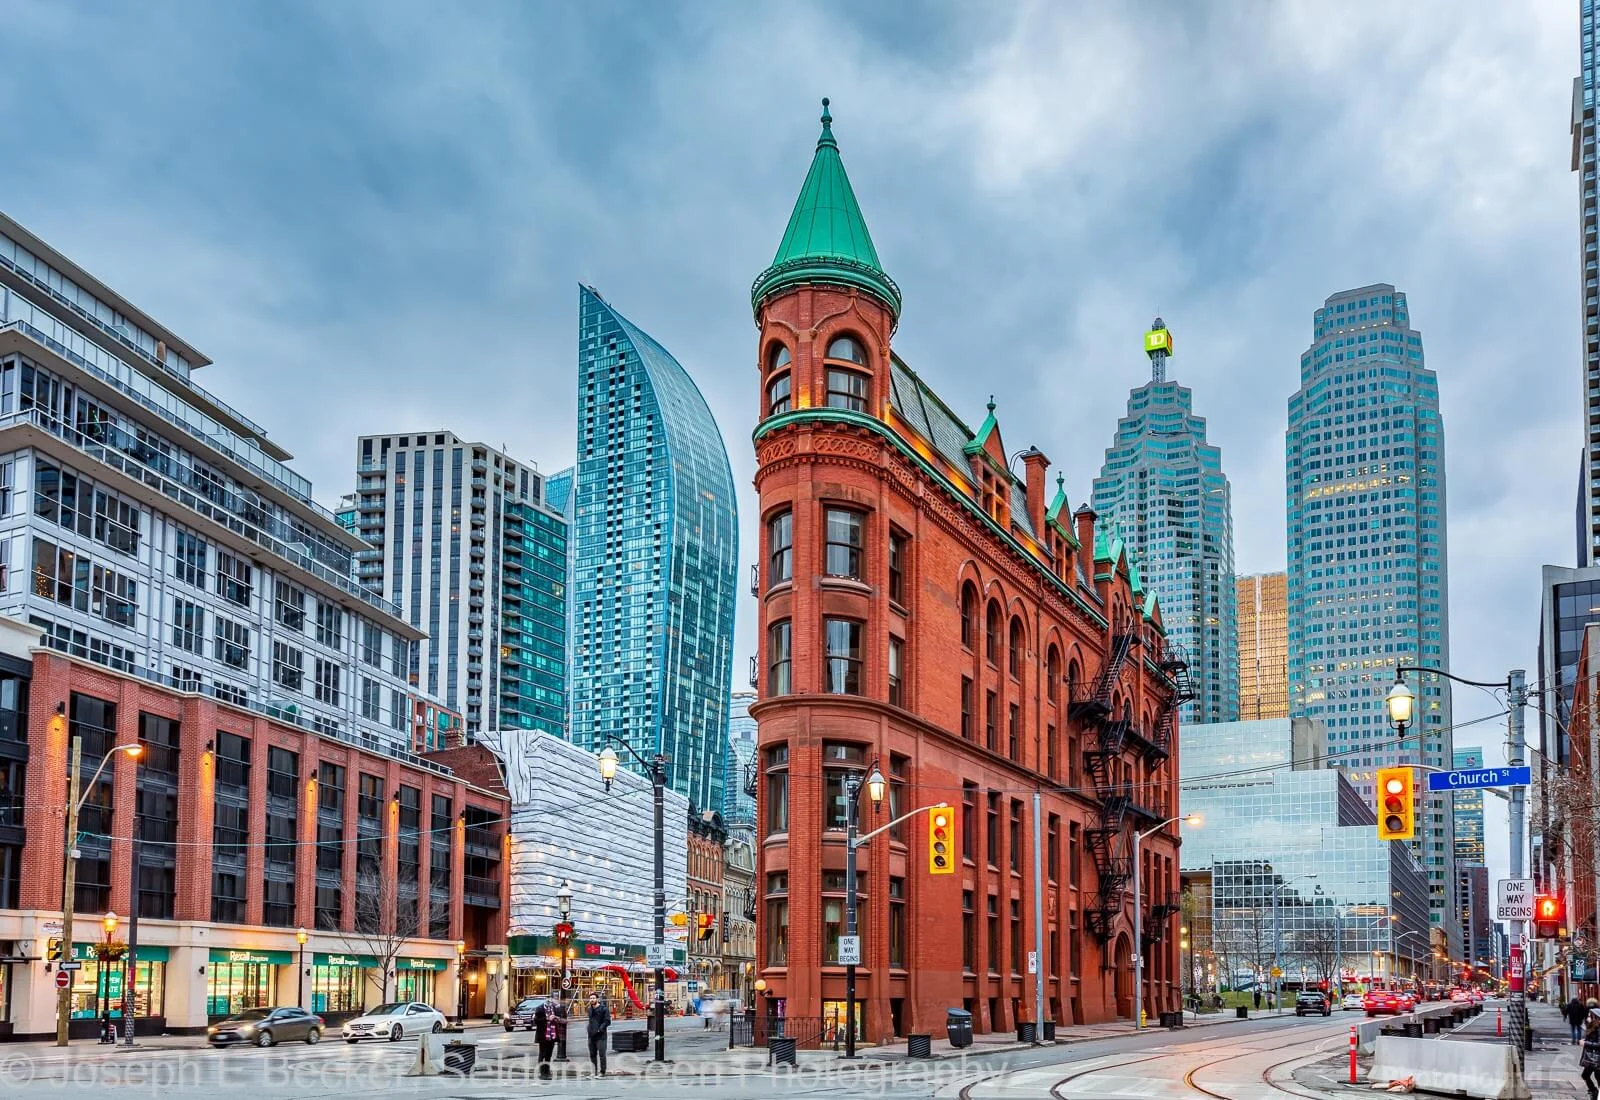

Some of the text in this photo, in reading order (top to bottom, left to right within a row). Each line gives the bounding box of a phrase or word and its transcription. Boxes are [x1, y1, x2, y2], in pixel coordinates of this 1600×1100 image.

[1448, 769, 1498, 786] Church
[1506, 882, 1525, 892] ONE
[1506, 894, 1525, 904] WAY
[1499, 907, 1532, 917] BEGINS
[843, 938, 855, 946] ONE
[652, 946, 660, 954] NO
[229, 951, 251, 962] Rexall
[328, 955, 345, 965] Rexall
